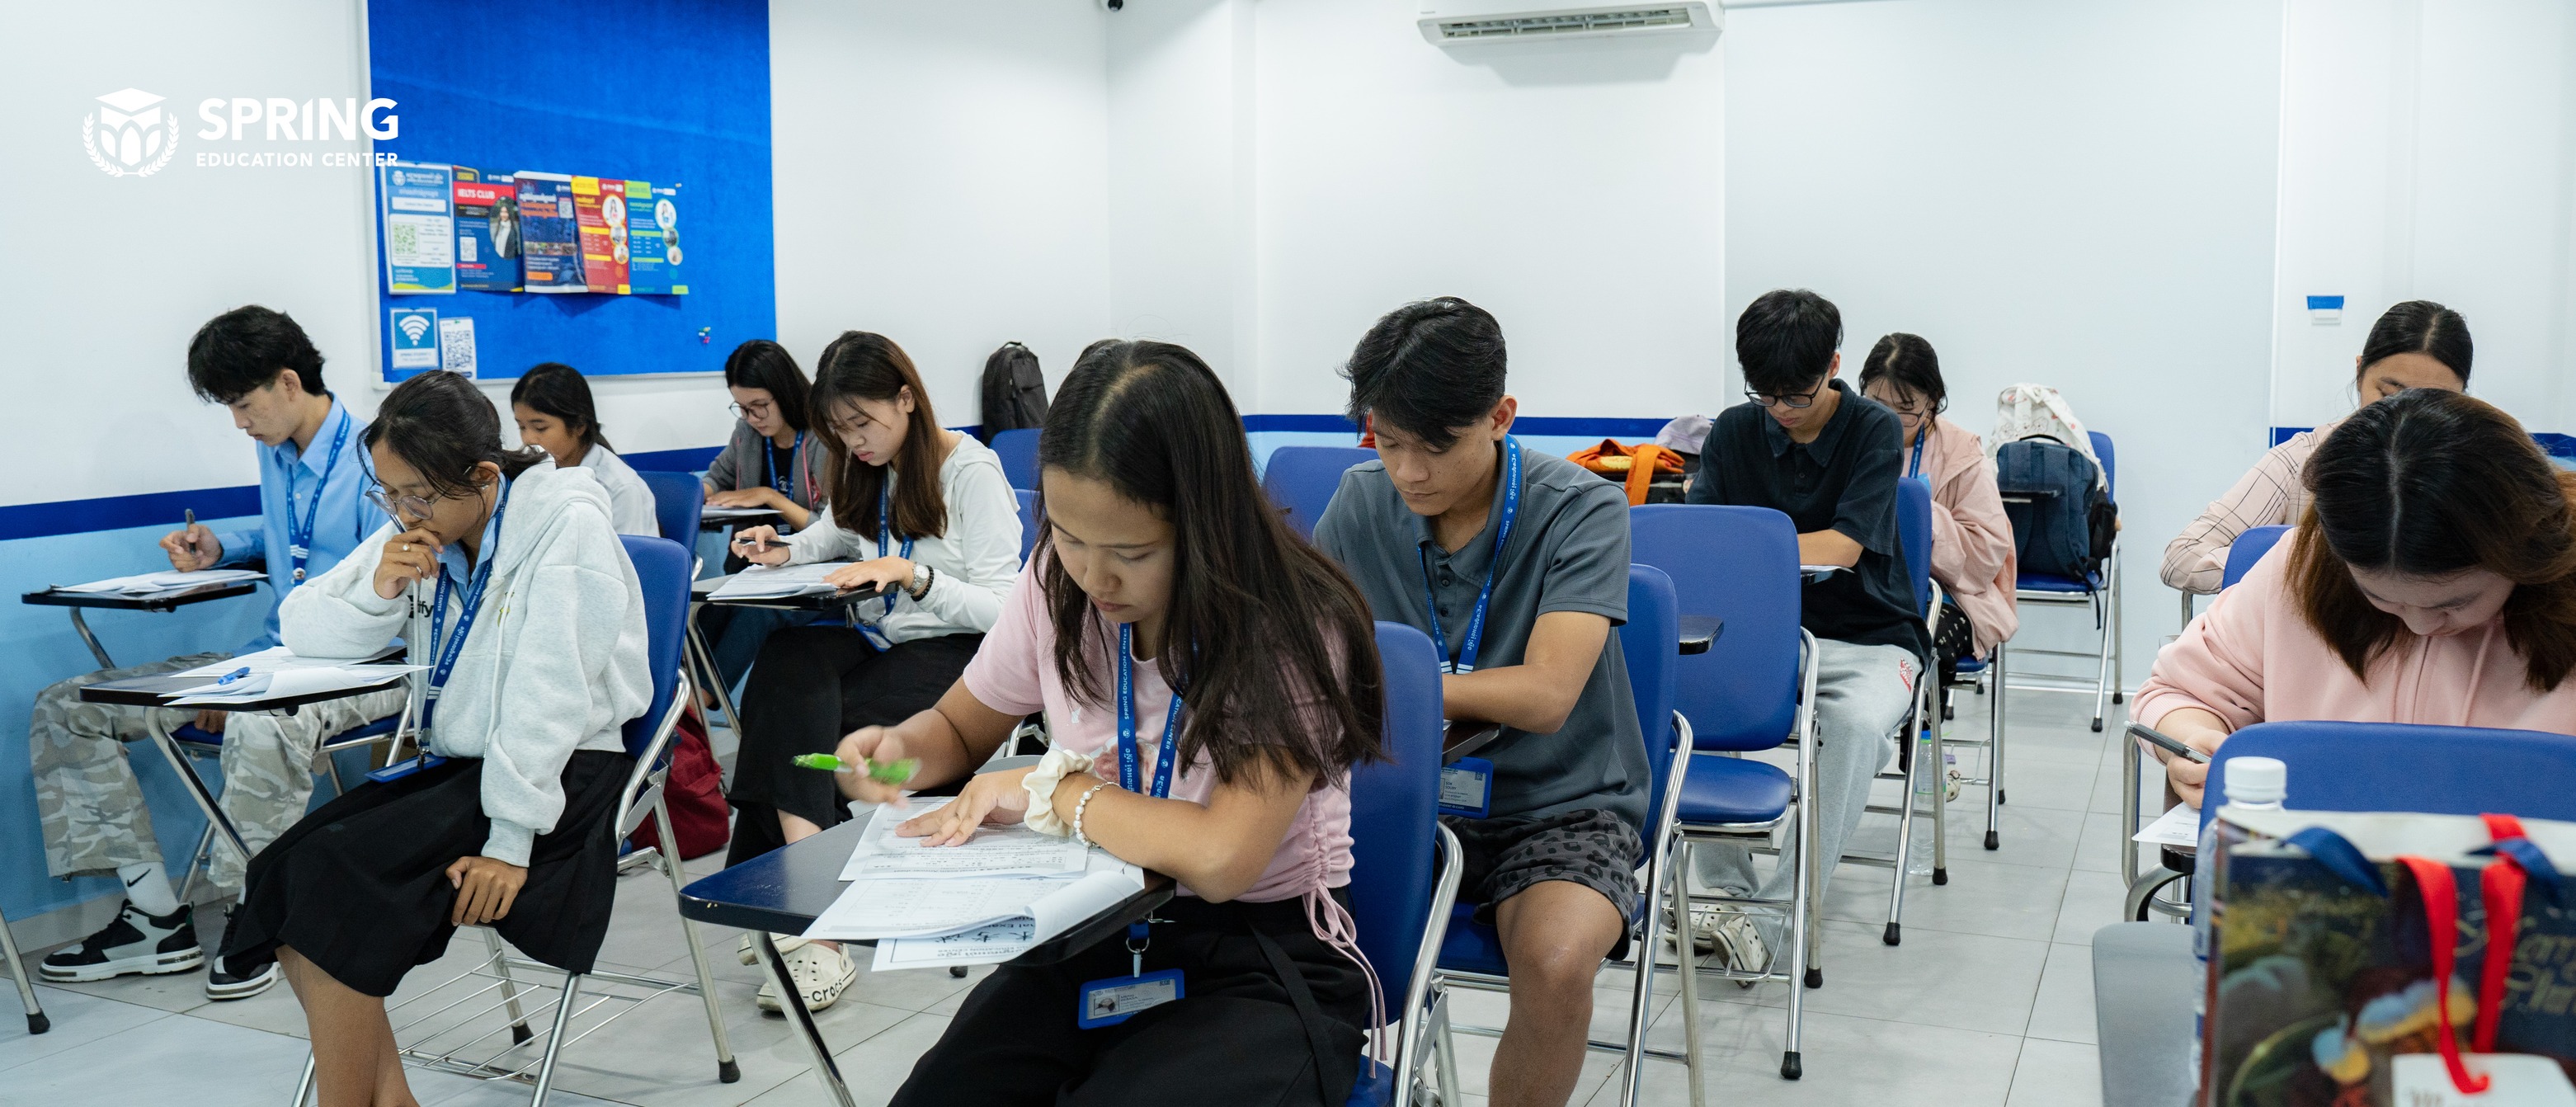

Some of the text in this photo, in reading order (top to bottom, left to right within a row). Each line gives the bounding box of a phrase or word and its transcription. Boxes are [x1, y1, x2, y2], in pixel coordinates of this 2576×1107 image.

[457, 188, 496, 200] IELTS CLUB
[1501, 521, 1510, 540] SPRING
[812, 978, 842, 1002] crocs
